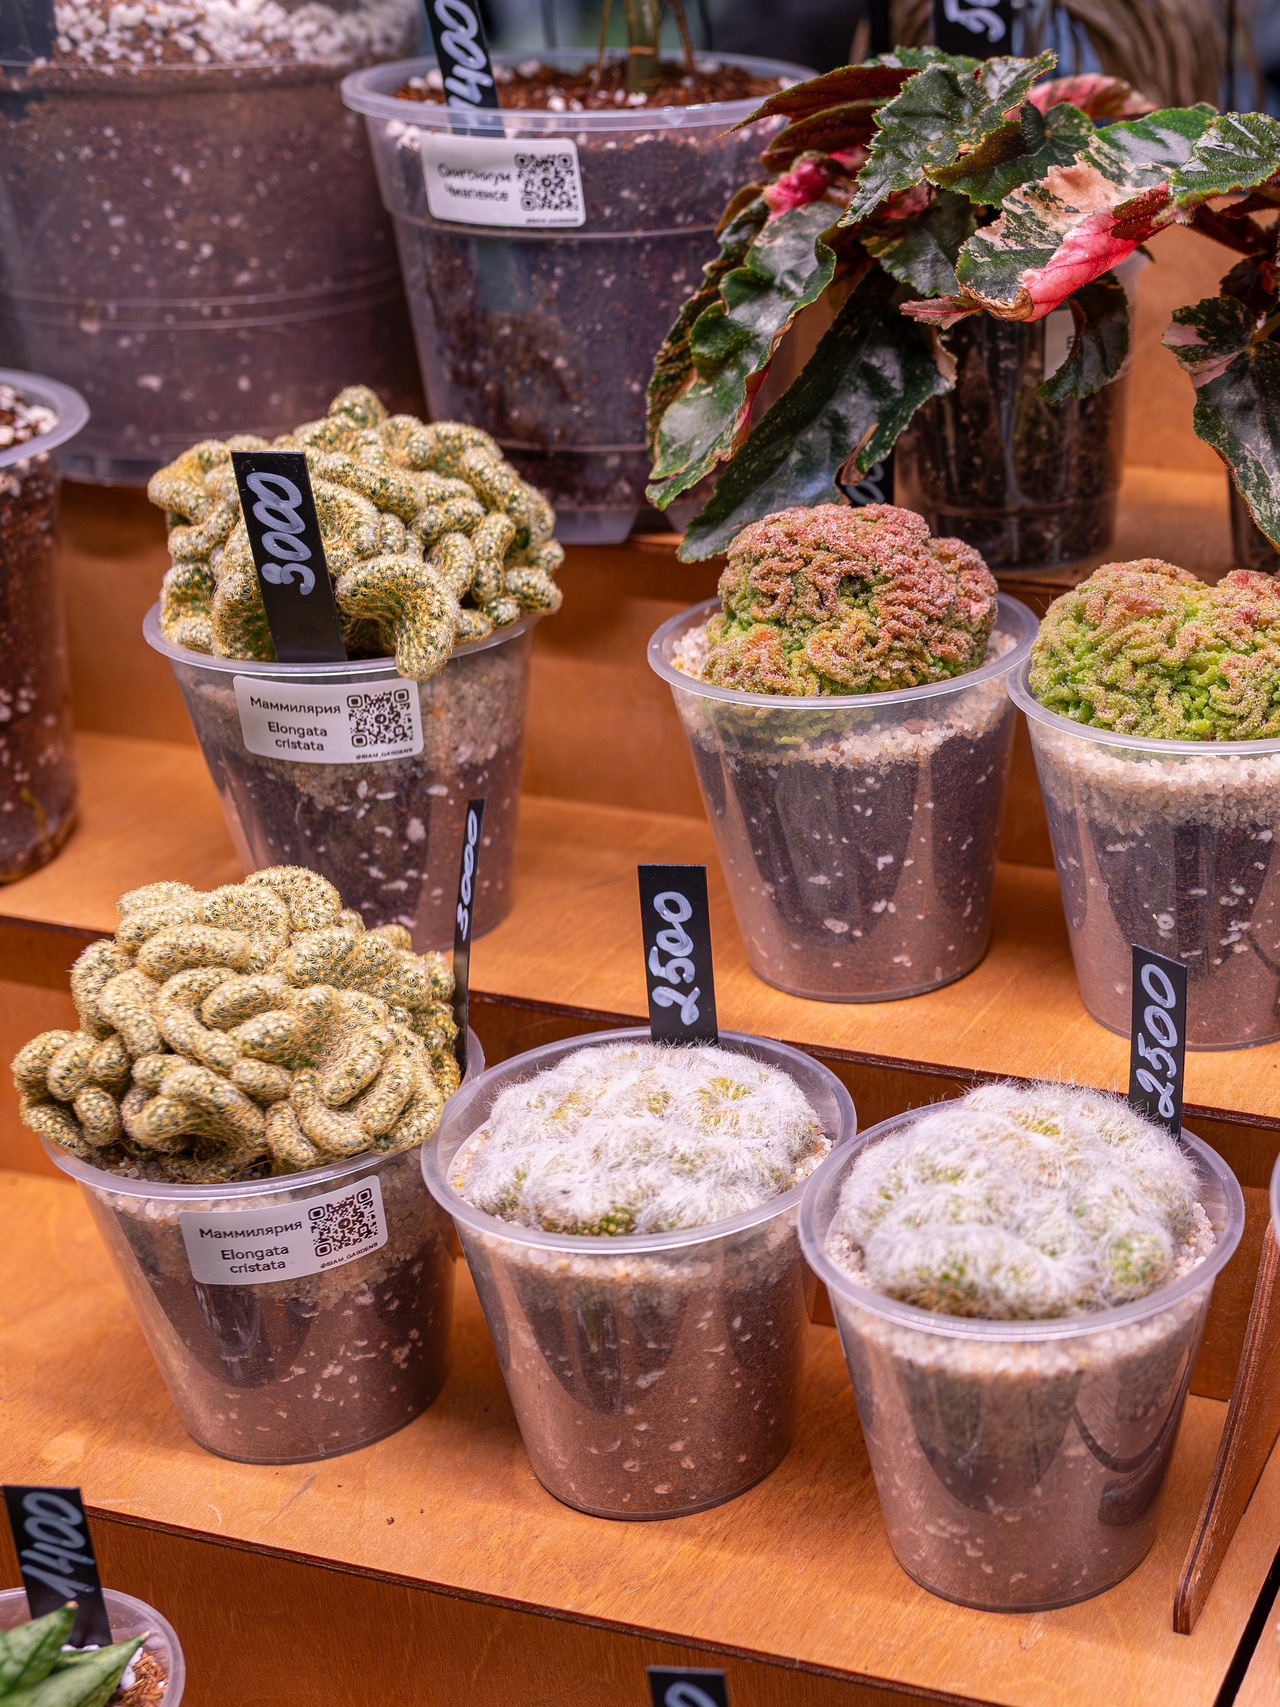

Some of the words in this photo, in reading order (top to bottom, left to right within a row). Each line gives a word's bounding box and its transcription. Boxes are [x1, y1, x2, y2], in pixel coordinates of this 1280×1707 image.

[246, 472, 316, 596] 3000
[249, 696, 342, 717] Маммилярия
[268, 721, 328, 738] Elongata
[275, 737, 325, 751] cristata
[649, 891, 701, 1026] 2500
[1136, 963, 1178, 1119] 2500
[199, 1221, 303, 1239] Маммилярия
[221, 1245, 289, 1261] Elongata
[230, 1260, 286, 1274] cristata
[20, 1491, 96, 1599] 1400
